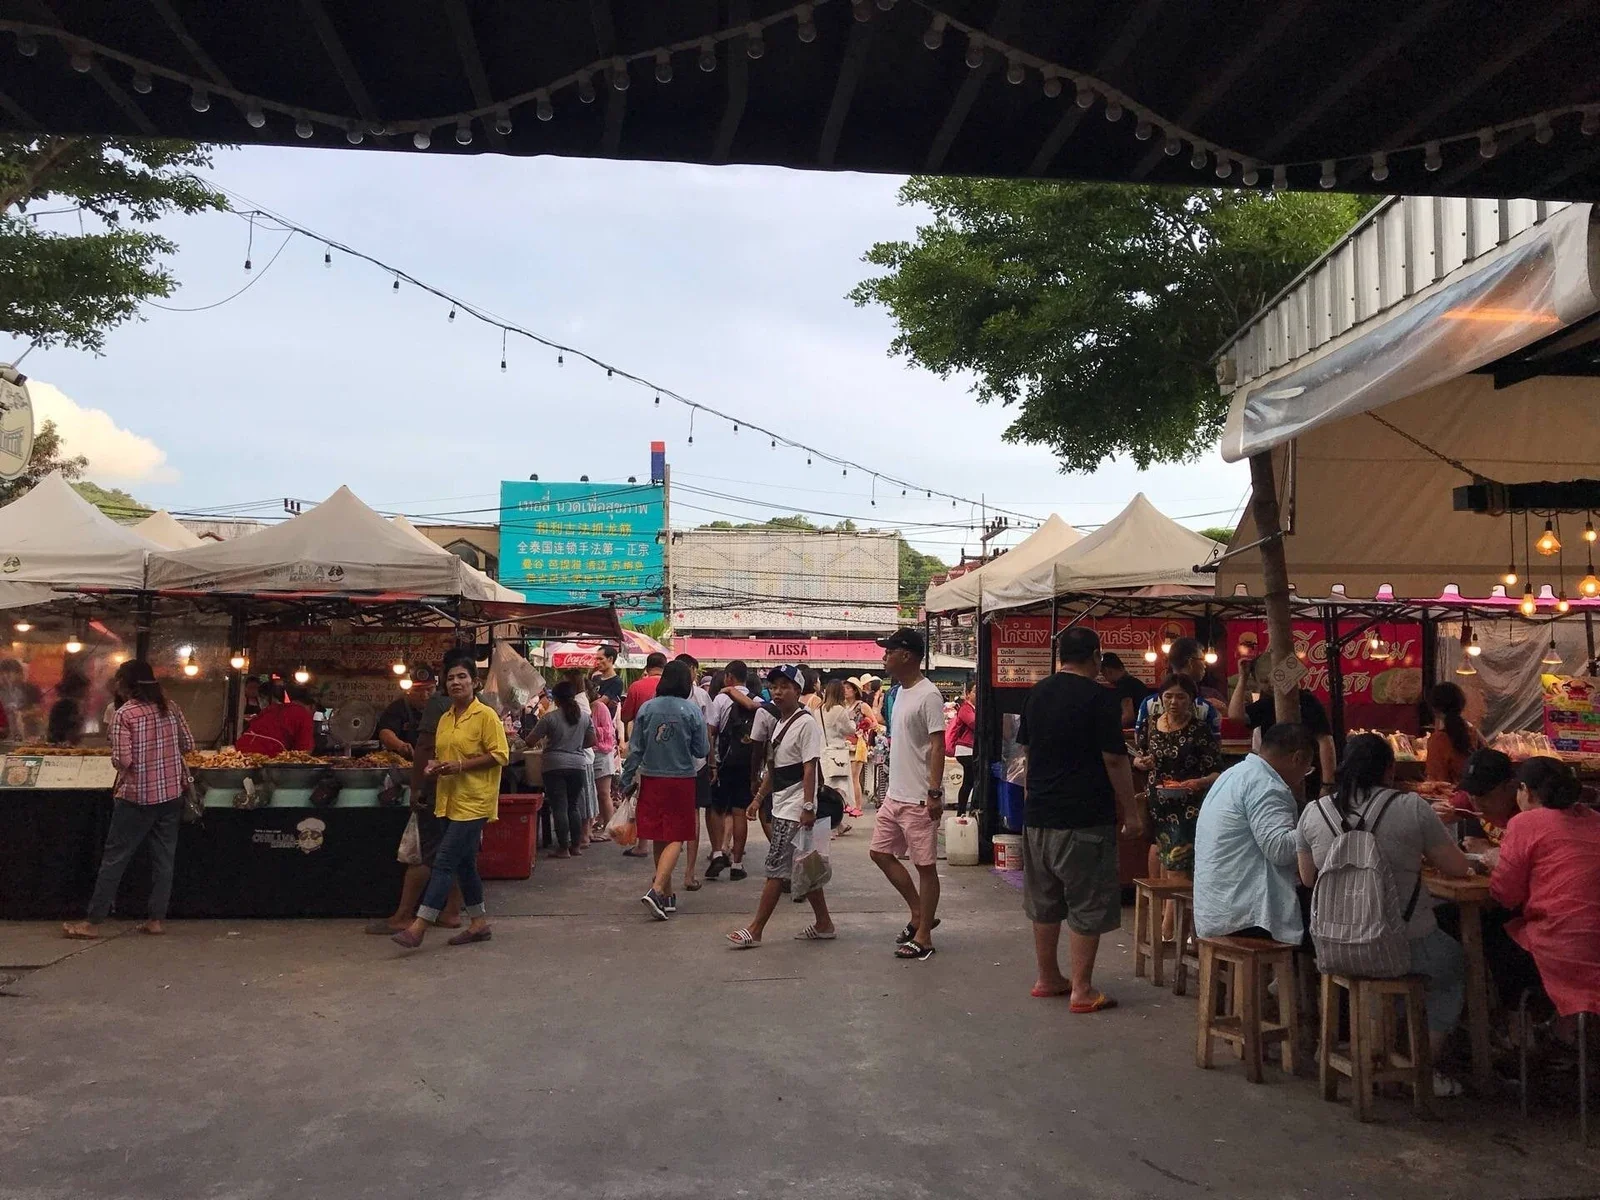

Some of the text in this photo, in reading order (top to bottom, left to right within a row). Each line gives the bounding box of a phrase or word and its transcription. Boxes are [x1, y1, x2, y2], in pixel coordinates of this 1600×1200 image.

[517, 541, 649, 556] 全泰国连锁手法第一正宗
[999, 622, 1049, 644] ไก่ย่าง
[768, 644, 808, 656] ALISSA
